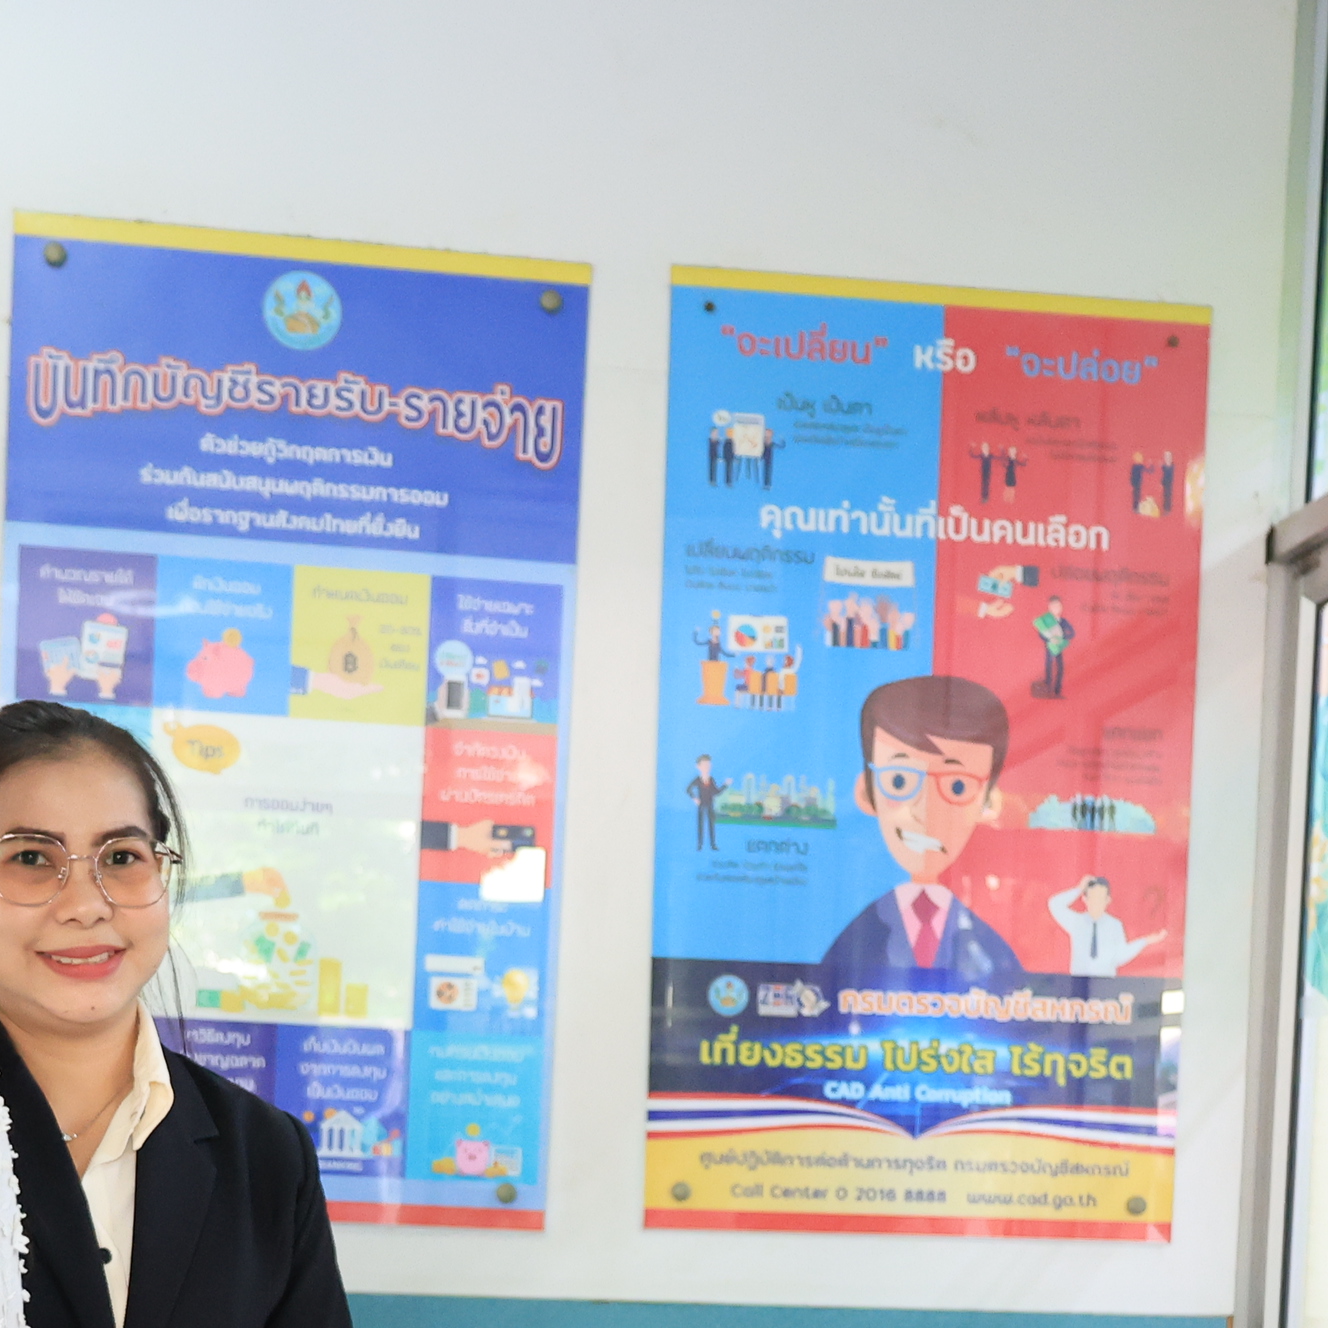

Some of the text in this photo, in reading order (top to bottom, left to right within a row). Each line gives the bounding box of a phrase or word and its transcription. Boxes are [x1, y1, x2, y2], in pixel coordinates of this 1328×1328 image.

[914, 338, 976, 374] หรือ
[28, 346, 564, 470] บันทึกบัญชีรายรับ-รายจ่าย
[139, 463, 449, 507] ร่วมกันสนับสนุนพฤติกรรมการออม
[166, 497, 420, 539] เพื่อรากฐานสังคมไทยที่ยั่งยืน
[760, 496, 1110, 551] คุณเท่านั้นที่เป็นคนเลือก
[186, 739, 225, 760] Tips
[838, 988, 1133, 1025] กรมตรวจบัญชีสหกรณ์
[699, 1024, 1133, 1087] เที่ยงธรรม โปร่งใส ไร้ทุจริต
[824, 1080, 1013, 1108] CAD Anti Corruption
[954, 1156, 1131, 1178] กรมตรวจบัญชีสหกรณ์
[730, 1183, 764, 1199] Call
[770, 1183, 829, 1200] Center
[966, 1193, 1098, 1211] www.cad.go.th
